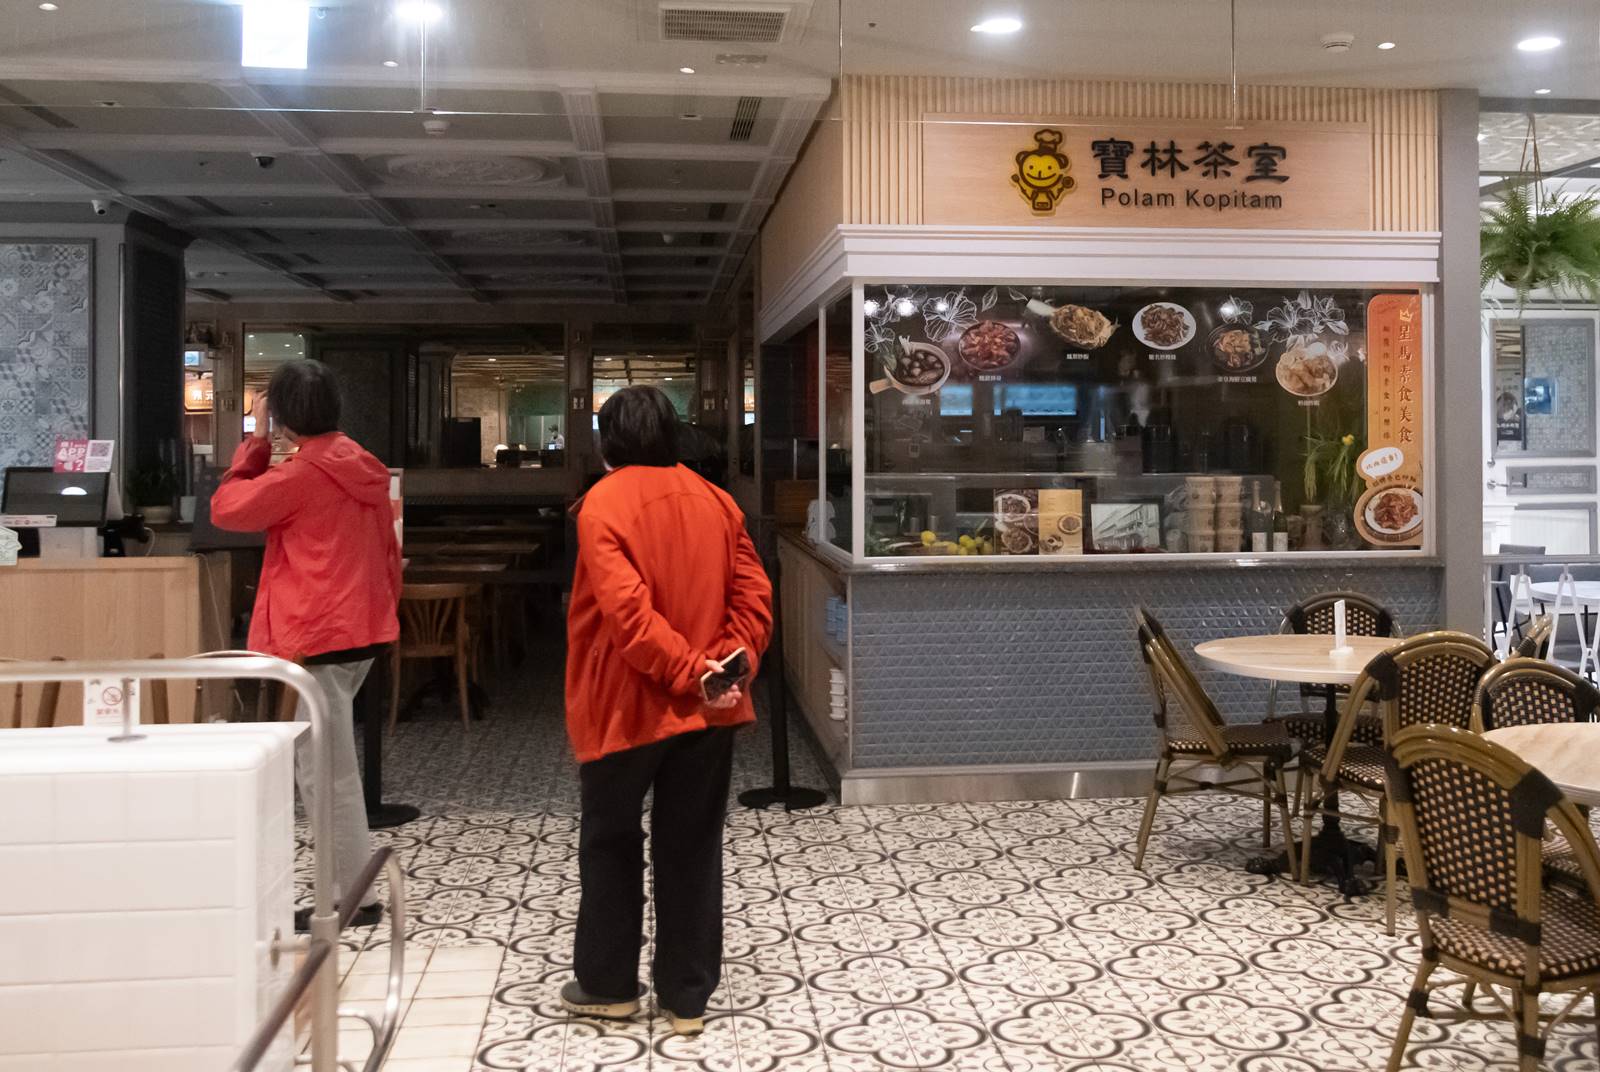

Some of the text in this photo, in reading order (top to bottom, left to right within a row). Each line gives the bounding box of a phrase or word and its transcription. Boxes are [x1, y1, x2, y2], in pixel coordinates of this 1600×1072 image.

[1091, 137, 1290, 183] 寶林茶室
[1101, 188, 1283, 211] Polam Kopitam
